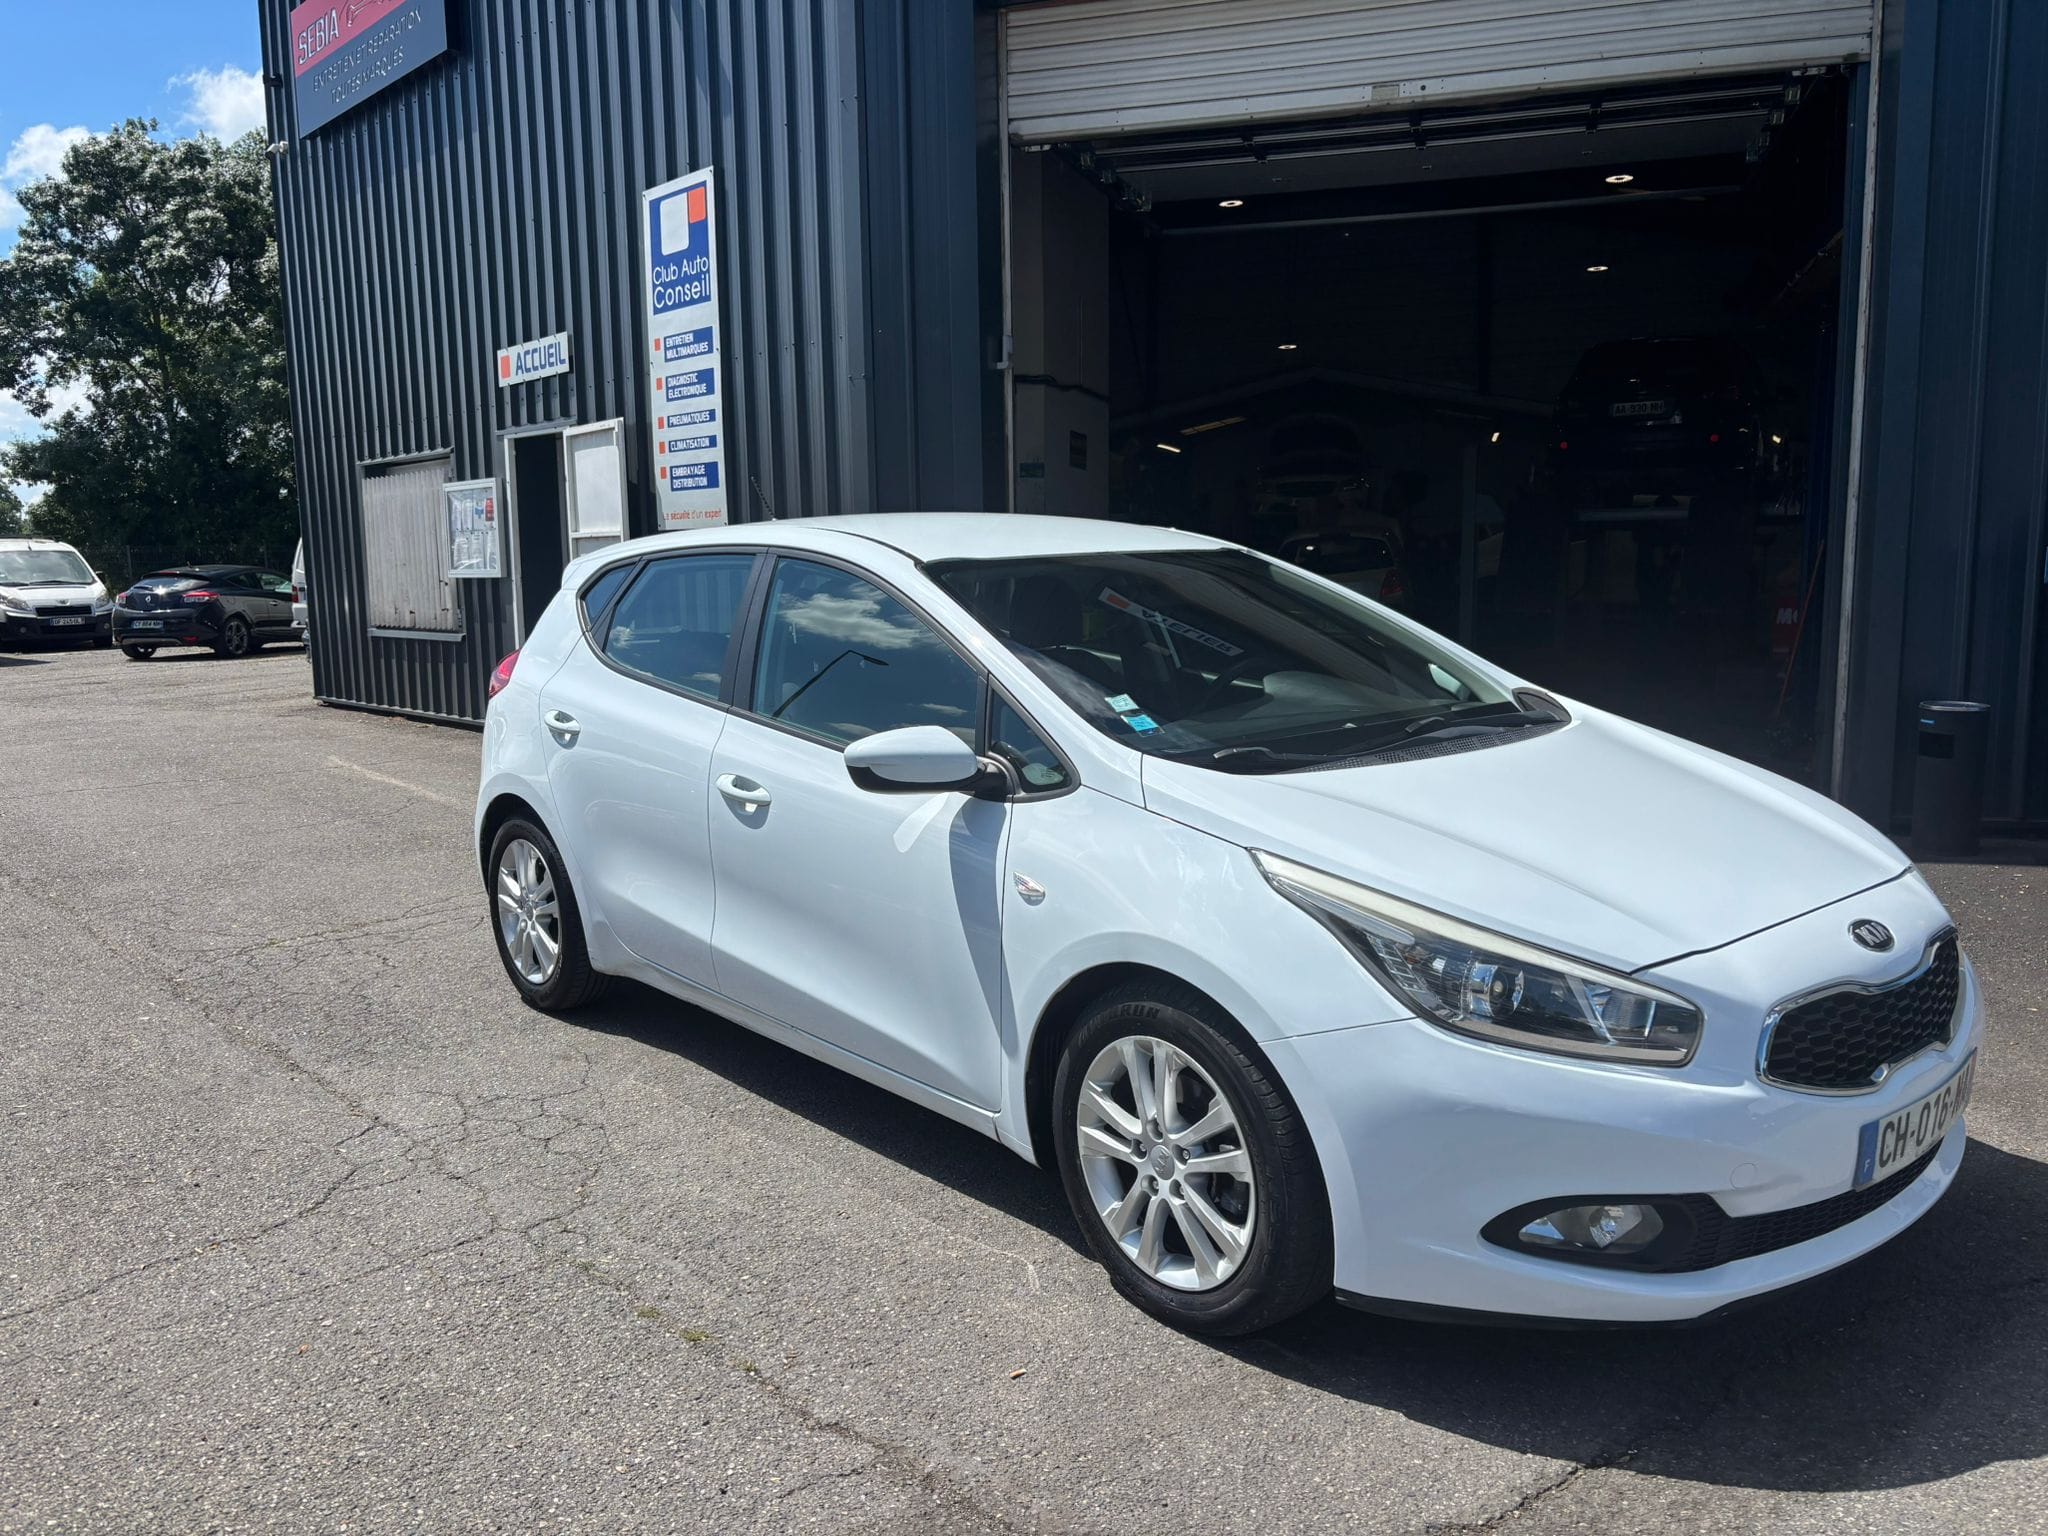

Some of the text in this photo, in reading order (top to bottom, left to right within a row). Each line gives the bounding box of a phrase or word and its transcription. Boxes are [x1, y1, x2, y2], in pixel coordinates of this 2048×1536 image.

[298, 9, 339, 65] SEBIA
[313, 54, 354, 93] ENTRETIEN
[356, 44, 367, 65] ET
[331, 46, 404, 103] TOUTES MARQUES
[653, 255, 709, 285] Club Auto
[654, 273, 710, 308] Conseil
[665, 333, 694, 348] ENTRETIEN
[666, 342, 709, 359] MULTIMARQUES
[515, 341, 567, 376] ACCUEIL
[667, 373, 698, 387] DIAGNOSTIC
[669, 411, 710, 426] PNEUMATIQUES
[670, 437, 710, 451] CLIMATISATION
[672, 465, 706, 477] EMBRAYAGE
[673, 476, 708, 489] DISTRIBUTION
[1854, 921, 1889, 945] KIA
